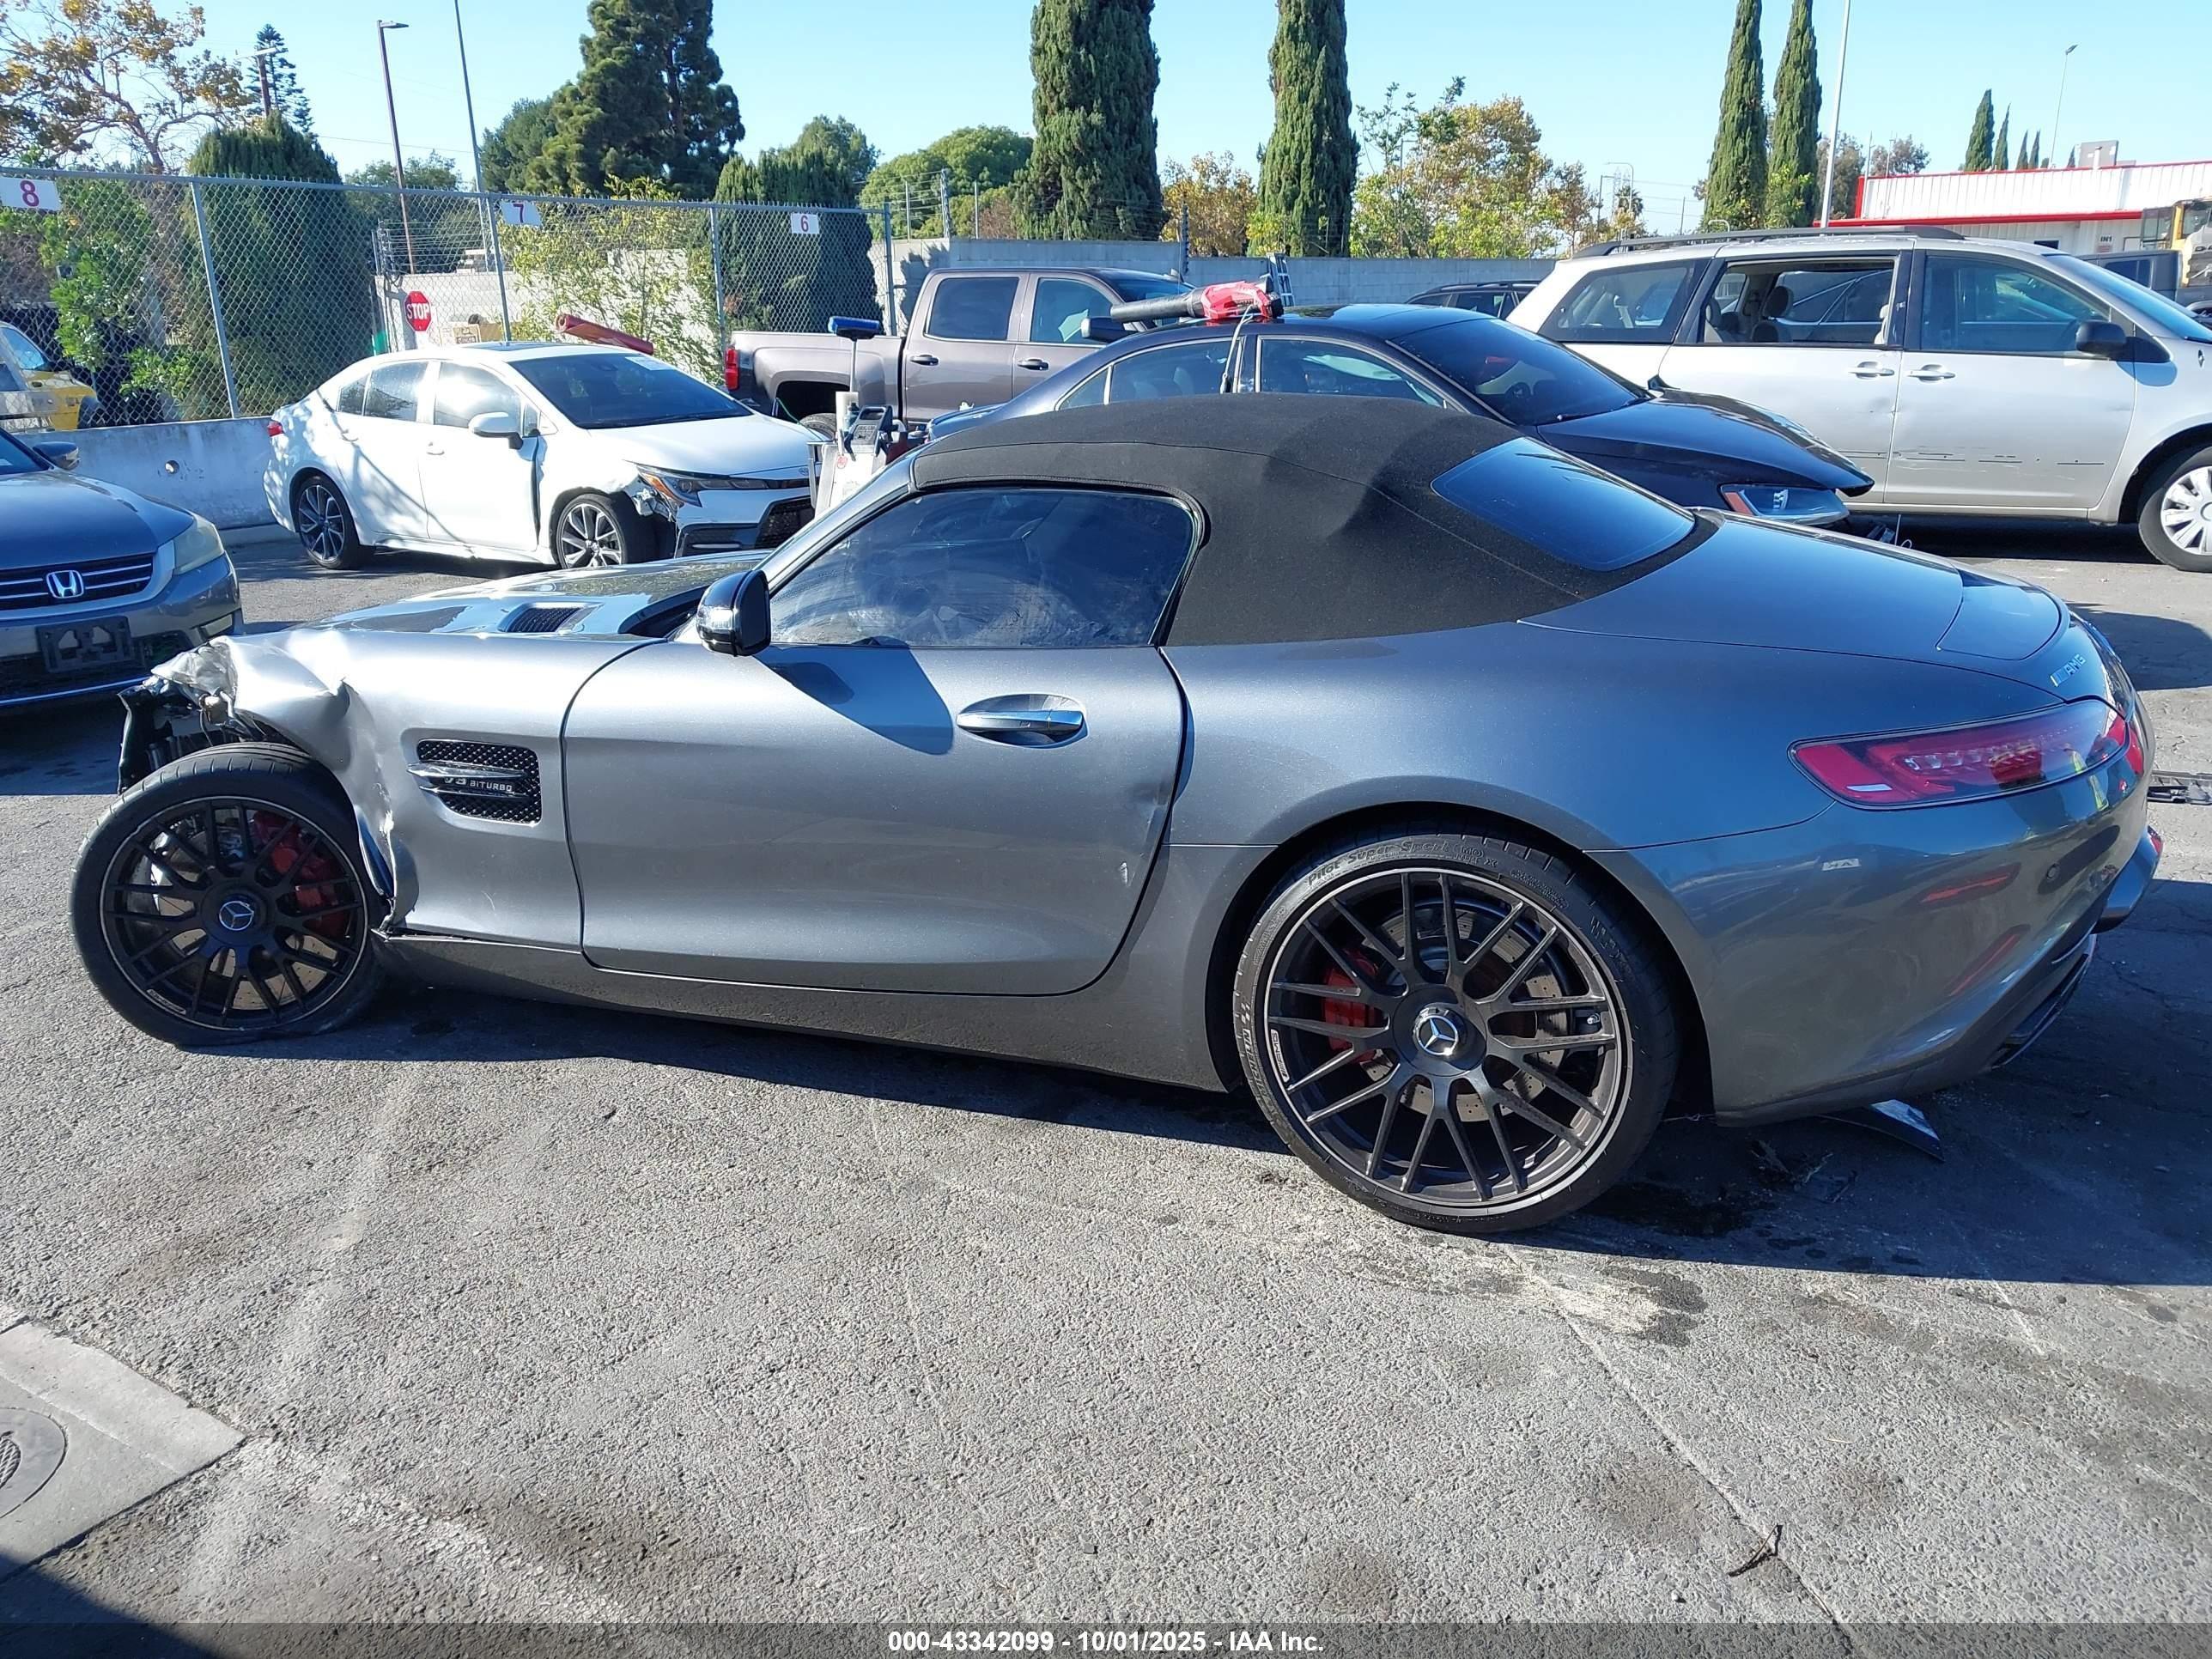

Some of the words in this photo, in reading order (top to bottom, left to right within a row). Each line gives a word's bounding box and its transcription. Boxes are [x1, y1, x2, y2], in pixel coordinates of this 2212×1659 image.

[20, 179, 40, 207] 8
[513, 203, 525, 223] 7
[800, 215, 809, 233] 6
[407, 303, 429, 319] STOP
